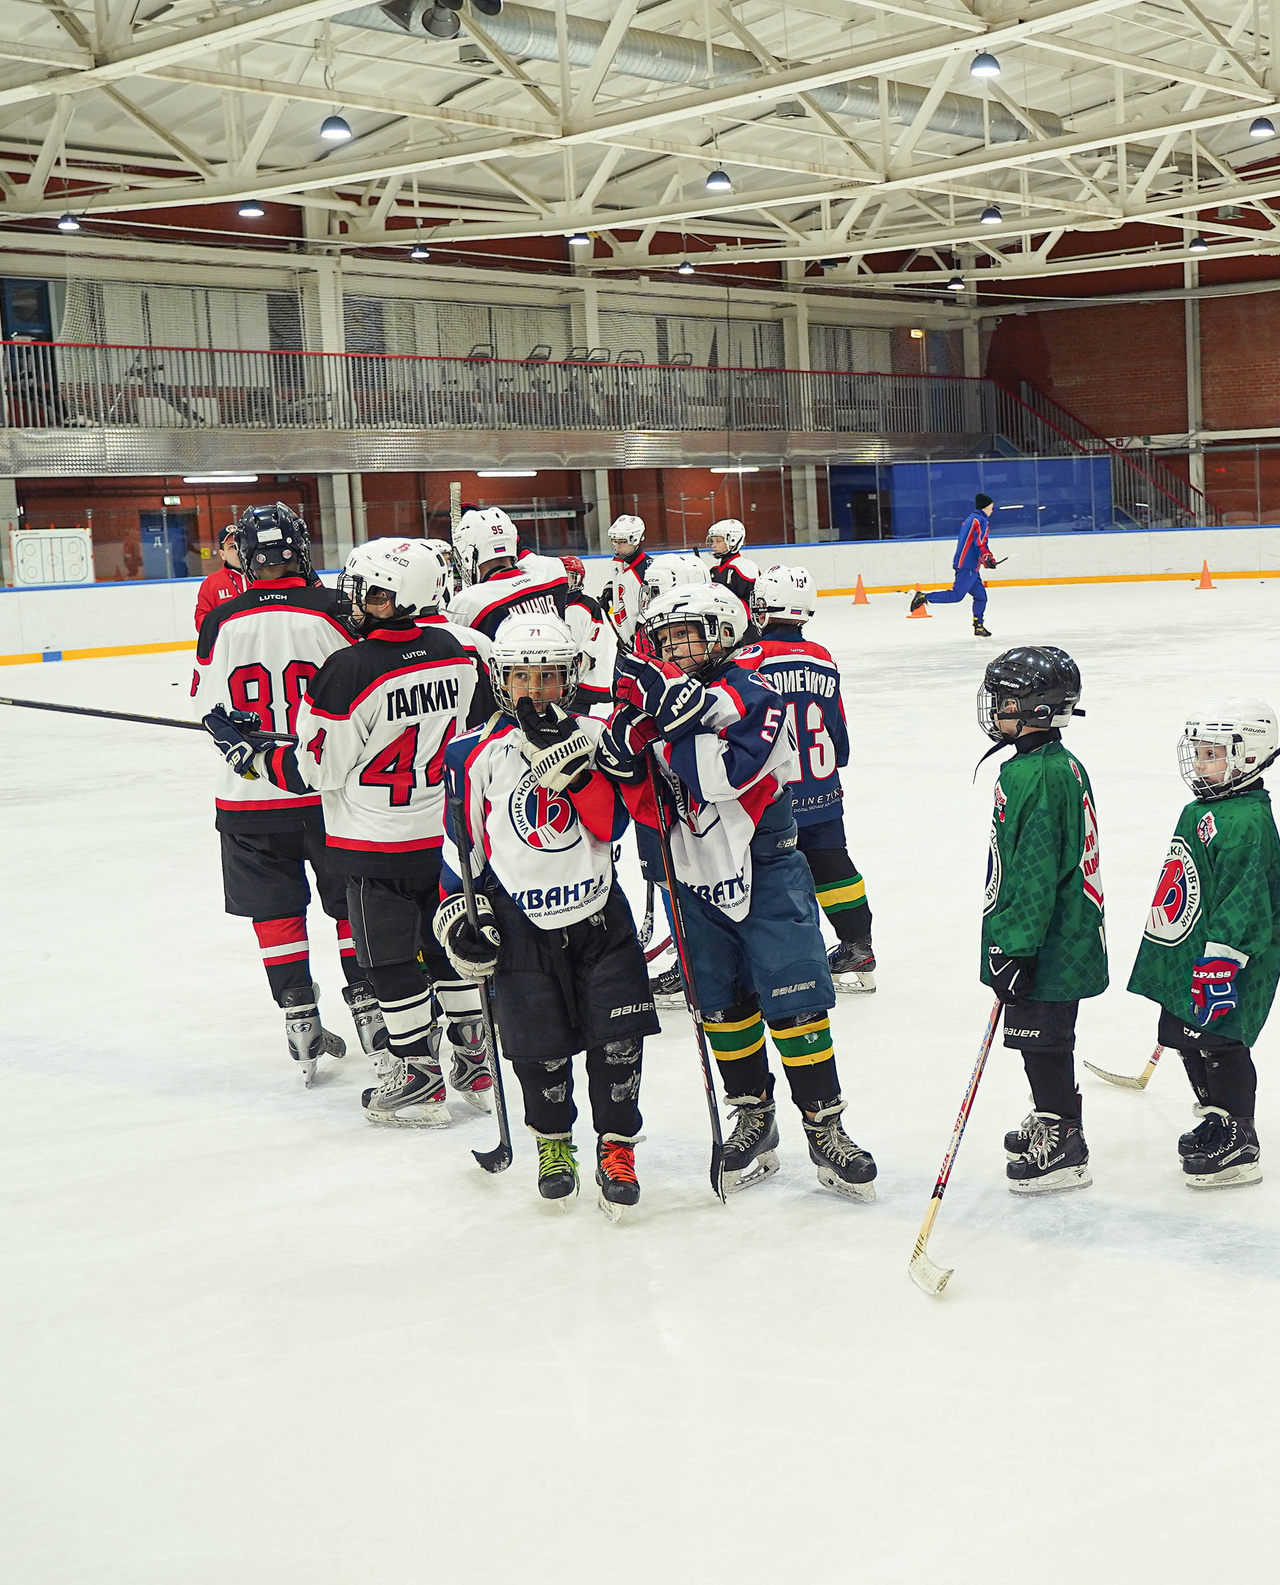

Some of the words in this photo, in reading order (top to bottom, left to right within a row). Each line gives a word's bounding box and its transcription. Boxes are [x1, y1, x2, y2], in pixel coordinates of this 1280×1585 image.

[491, 525, 504, 535] 95
[384, 553, 410, 568] CCM
[795, 578, 805, 589] 13
[259, 594, 288, 602] LUTCH
[528, 628, 541, 638] 71
[402, 650, 427, 660] LUTCH
[387, 678, 459, 722] ГАЛКИН
[1242, 726, 1267, 735] BAUER
[784, 700, 837, 783] 13
[533, 734, 591, 780] WARRIOR
[514, 802, 531, 836] VIKHR
[434, 896, 487, 938] WARRIR
[1180, 892, 1198, 928] VIKHR
[610, 1001, 655, 1018] BAUER
[1003, 1027, 1041, 1039] BAUER
